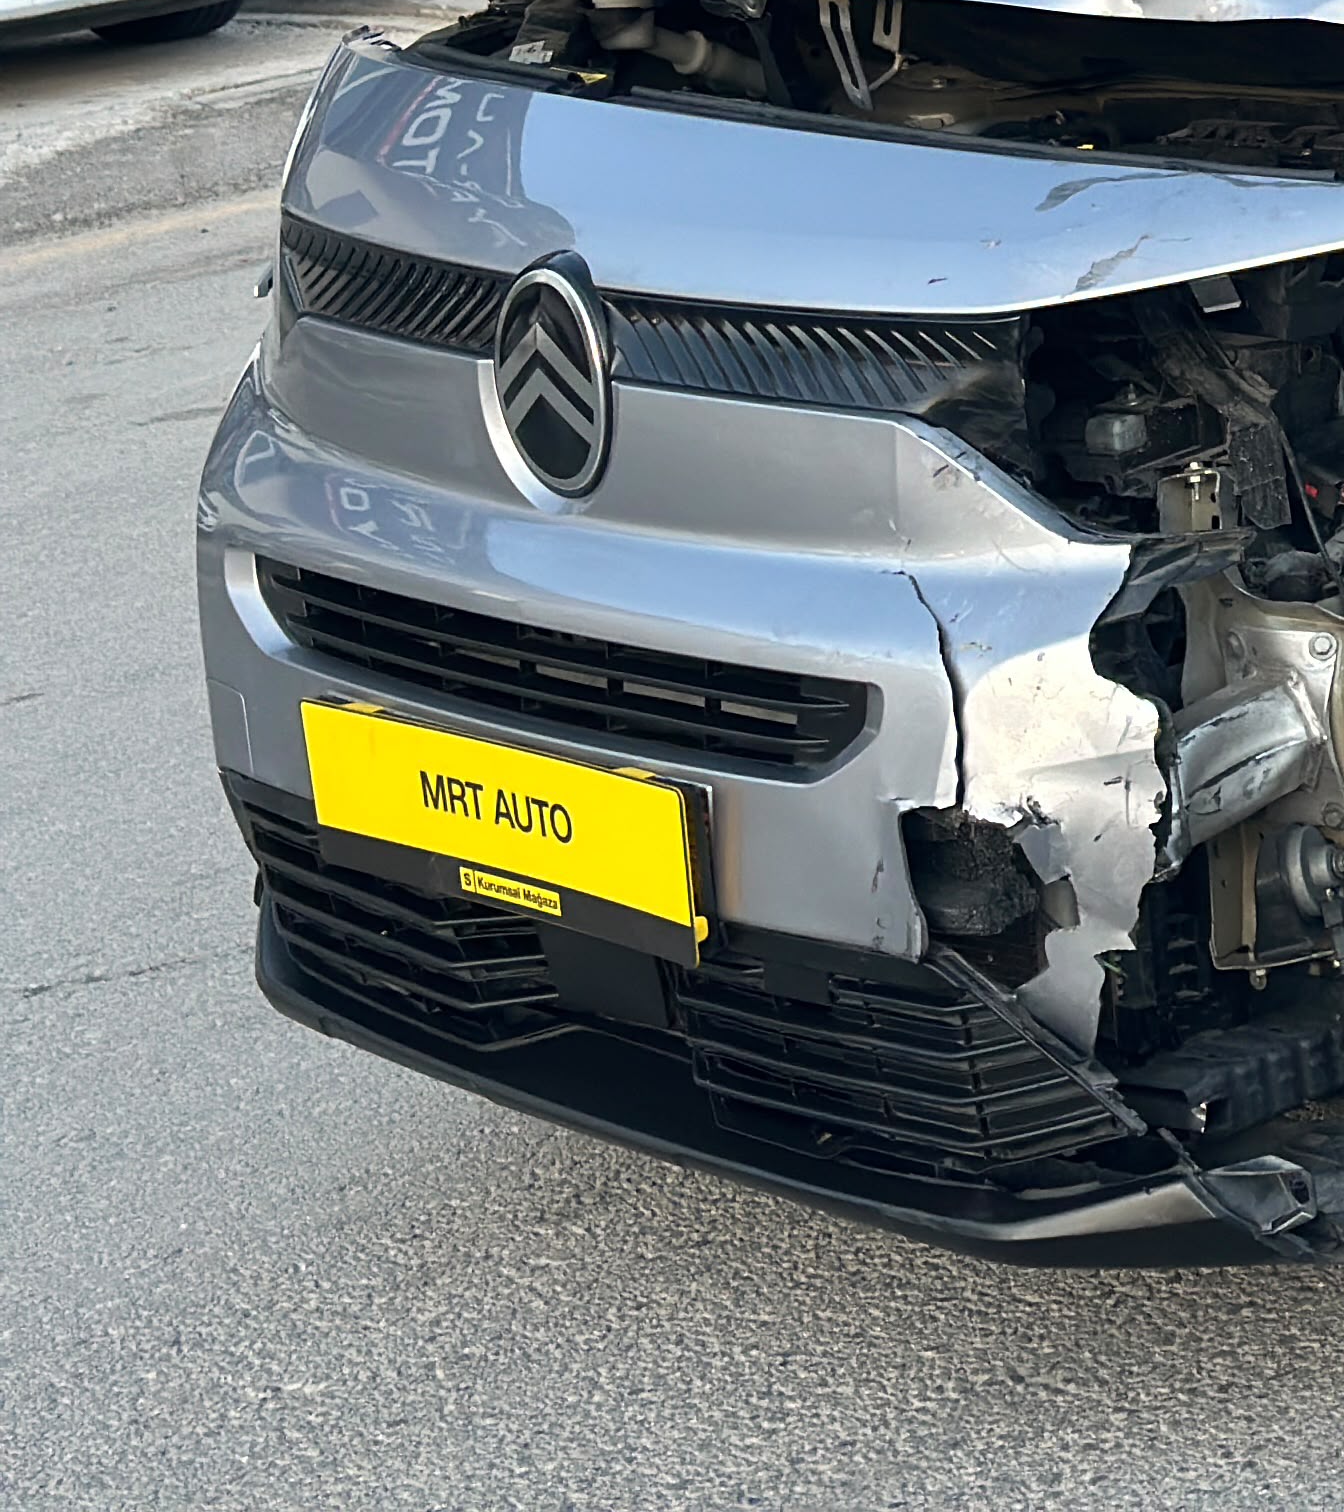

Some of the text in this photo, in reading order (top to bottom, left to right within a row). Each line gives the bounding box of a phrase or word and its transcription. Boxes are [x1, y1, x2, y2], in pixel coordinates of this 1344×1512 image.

[419, 770, 574, 844] MRT AUTO
[477, 875, 521, 900] Kurumsal
